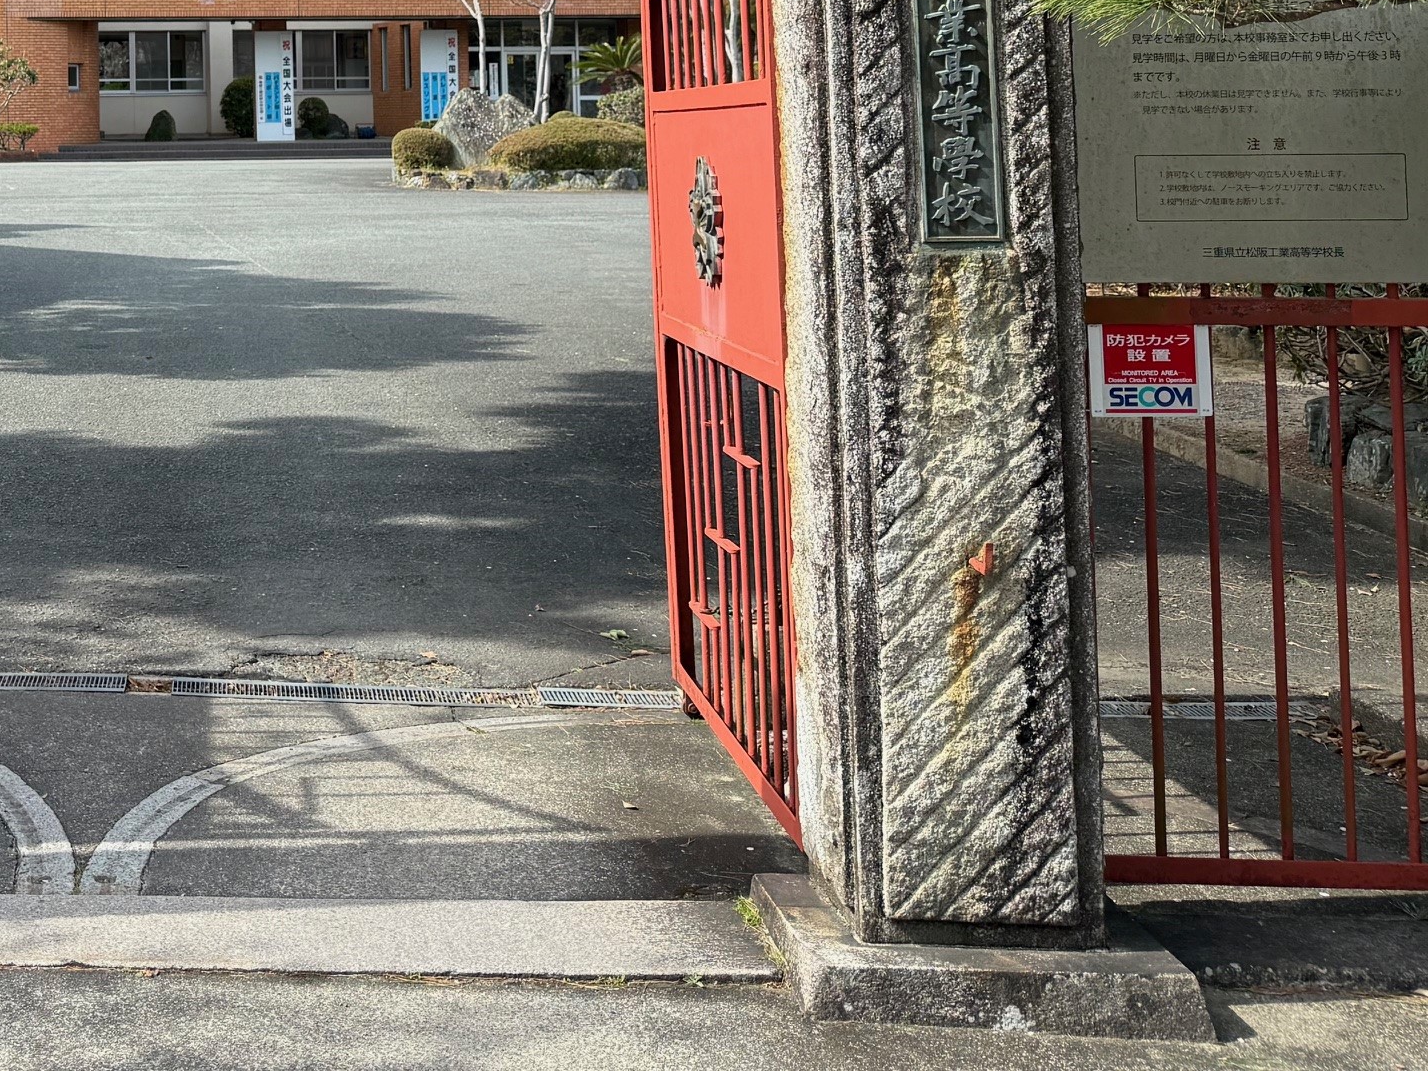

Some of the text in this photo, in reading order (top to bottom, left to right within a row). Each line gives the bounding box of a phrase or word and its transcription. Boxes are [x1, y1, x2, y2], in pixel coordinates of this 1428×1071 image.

[1133, 72, 1180, 82] までです。
[283, 56, 292, 127] 全国大会出場
[1202, 246, 1345, 258] 三重県立松阪工業高等学校長
[1106, 334, 1190, 347] 防犯カメラ
[1166, 377, 1193, 385] Operation
[1109, 386, 1192, 407] SECOM
